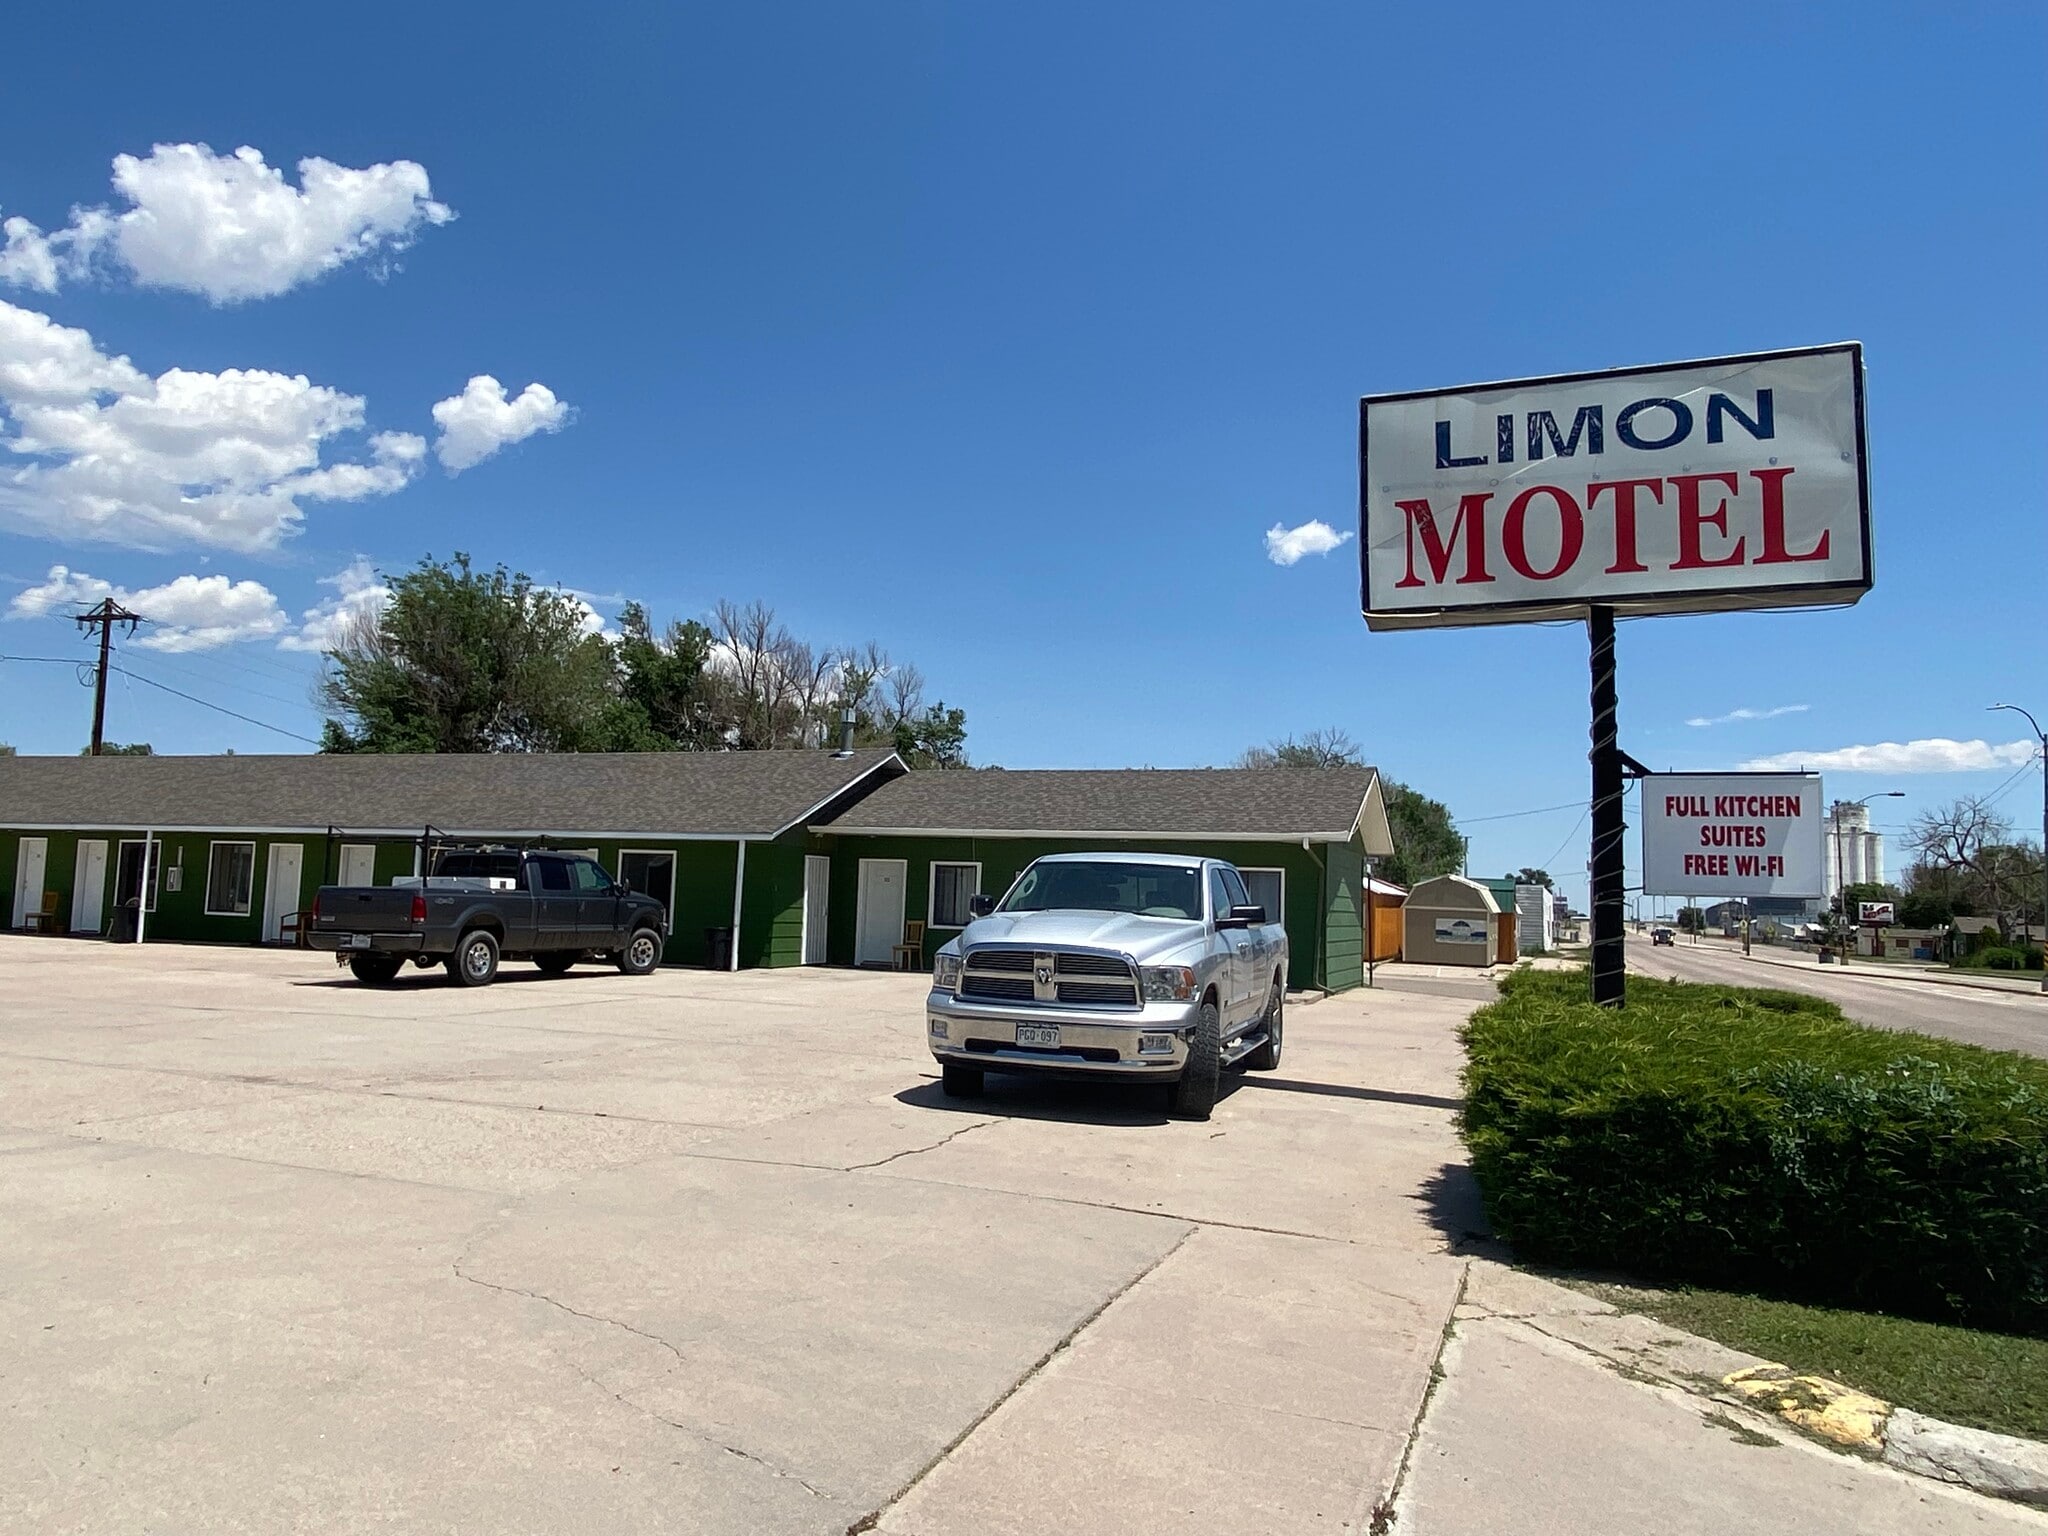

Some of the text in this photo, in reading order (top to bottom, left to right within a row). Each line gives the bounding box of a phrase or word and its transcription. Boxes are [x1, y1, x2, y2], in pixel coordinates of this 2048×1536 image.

[1435, 388, 1776, 469] LIMON
[1394, 467, 1830, 588] MOTEL
[1665, 796, 1801, 817] FULL KITCHEN
[1700, 825, 1766, 847] SUITES
[1684, 854, 1784, 877] FREE WI-FI
[1040, 1030, 1058, 1043] 097
